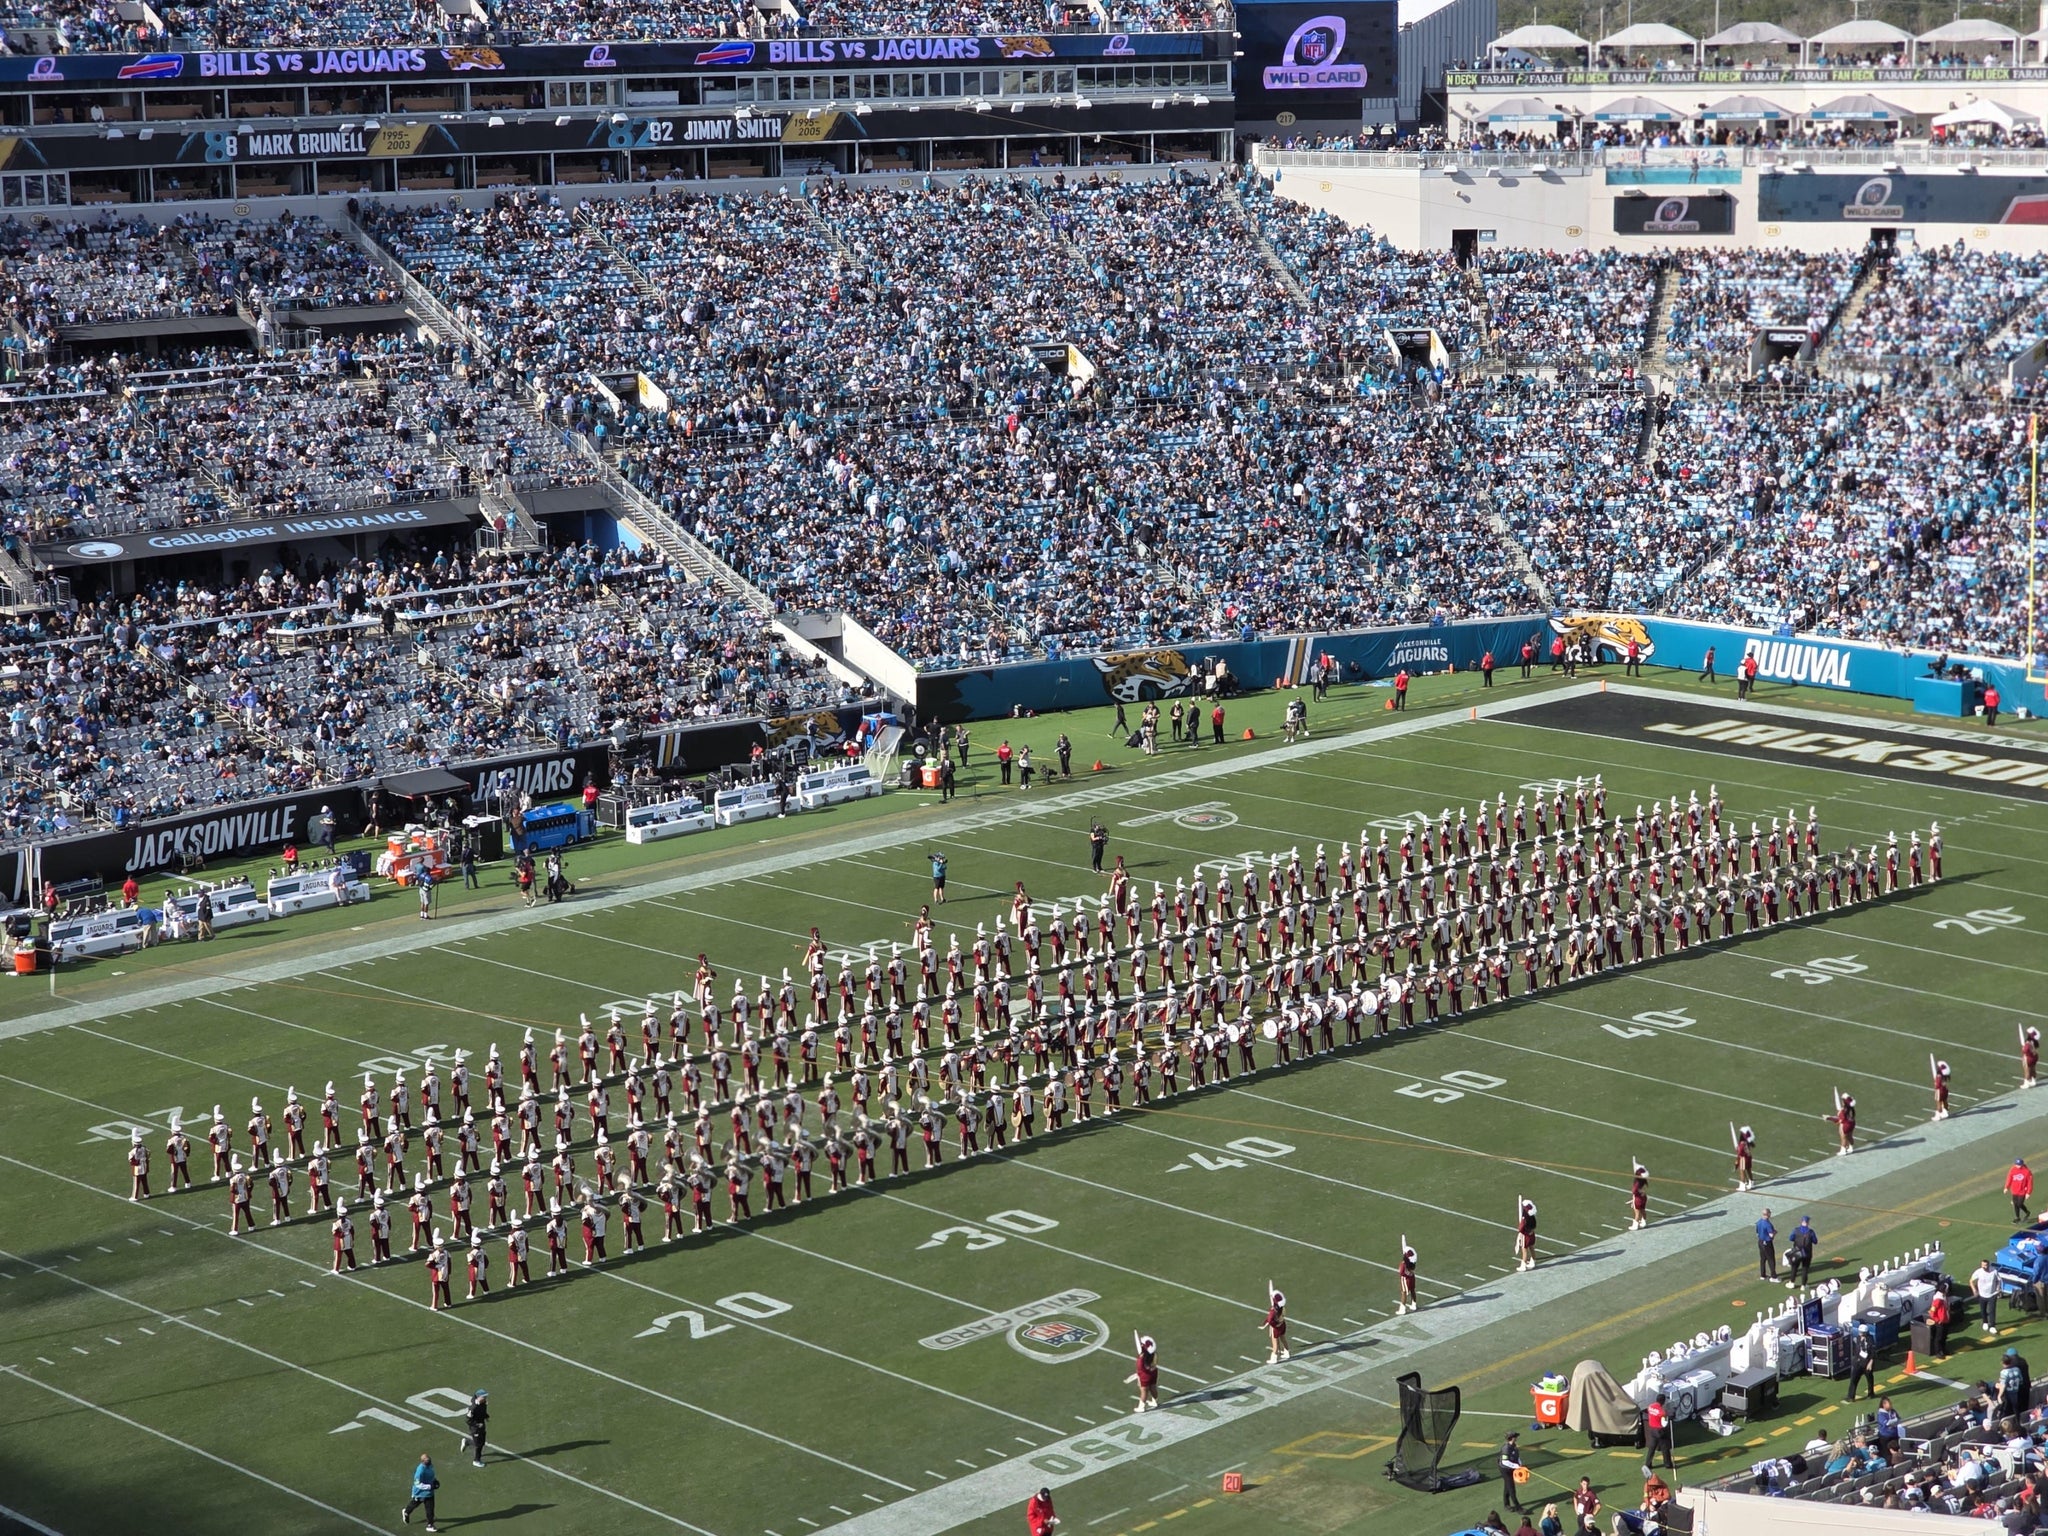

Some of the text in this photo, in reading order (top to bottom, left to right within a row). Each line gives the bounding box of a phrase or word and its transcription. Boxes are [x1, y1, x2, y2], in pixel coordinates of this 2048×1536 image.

[770, 41, 834, 62] BILLS
[872, 37, 981, 61] JAGUARS
[1304, 44, 1325, 58] NFL
[200, 53, 270, 77] BILLS
[310, 49, 427, 74] JAGUARS
[1269, 71, 1361, 84] WILD CARD
[1455, 73, 1477, 85] DECK
[1481, 75, 1514, 84] FARAH
[1529, 74, 1563, 84] FARAH
[1567, 73, 1585, 84] FAN
[1587, 73, 1609, 84] DECK
[1613, 74, 1646, 83] FARAH
[1661, 73, 1695, 82] FARAH
[1699, 72, 1716, 82] FAN
[1718, 71, 1741, 82] DECK
[1745, 72, 1779, 81] FARAH
[1794, 72, 1828, 81] FARAH
[1832, 71, 1850, 81] FAN
[1852, 71, 1875, 80] DECK
[1878, 72, 1912, 80] FARAH
[1928, 71, 1962, 80] FARAH
[1966, 70, 1984, 80] FAN
[1986, 70, 2009, 79] DECK
[2013, 71, 2047, 79] FARAH
[794, 118, 820, 128] 1995-
[1279, 114, 1293, 123] 217
[382, 130, 410, 142] 1995-
[650, 121, 674, 142] 82
[684, 119, 731, 141] JIMMY
[737, 118, 782, 139] SMITH
[798, 126, 821, 137] 2005
[226, 136, 239, 157] 8
[249, 133, 294, 156] MARK
[300, 131, 367, 155] BRUNELL
[387, 140, 411, 151] 2003
[901, 178, 911, 186] 215
[237, 205, 247, 213] 212
[1847, 208, 1900, 216] WILD CARD
[1646, 223, 1697, 231] WILD CARD
[1039, 349, 1065, 358] EICO
[148, 509, 428, 549] Gallagher INSURANCE
[1388, 647, 1449, 668] JAGUARS
[126, 804, 298, 873] JACKSONVILLE
[1933, 908, 2027, 935] 20
[1770, 957, 1869, 986] 30
[1600, 1010, 1697, 1039] 40
[1393, 1070, 1507, 1104] 50
[86, 1106, 211, 1140] 20
[1187, 1136, 1297, 1171] 40
[930, 1209, 1060, 1251] 30
[651, 1292, 794, 1339] 20
[934, 1292, 1089, 1347] WILD CARD
[1031, 1322, 1074, 1341] NFL
[1029, 1320, 1434, 1476] AMERICA 250
[1541, 1399, 1557, 1417] G
[356, 1387, 472, 1433] 10
[1226, 1475, 1240, 1490] 20
